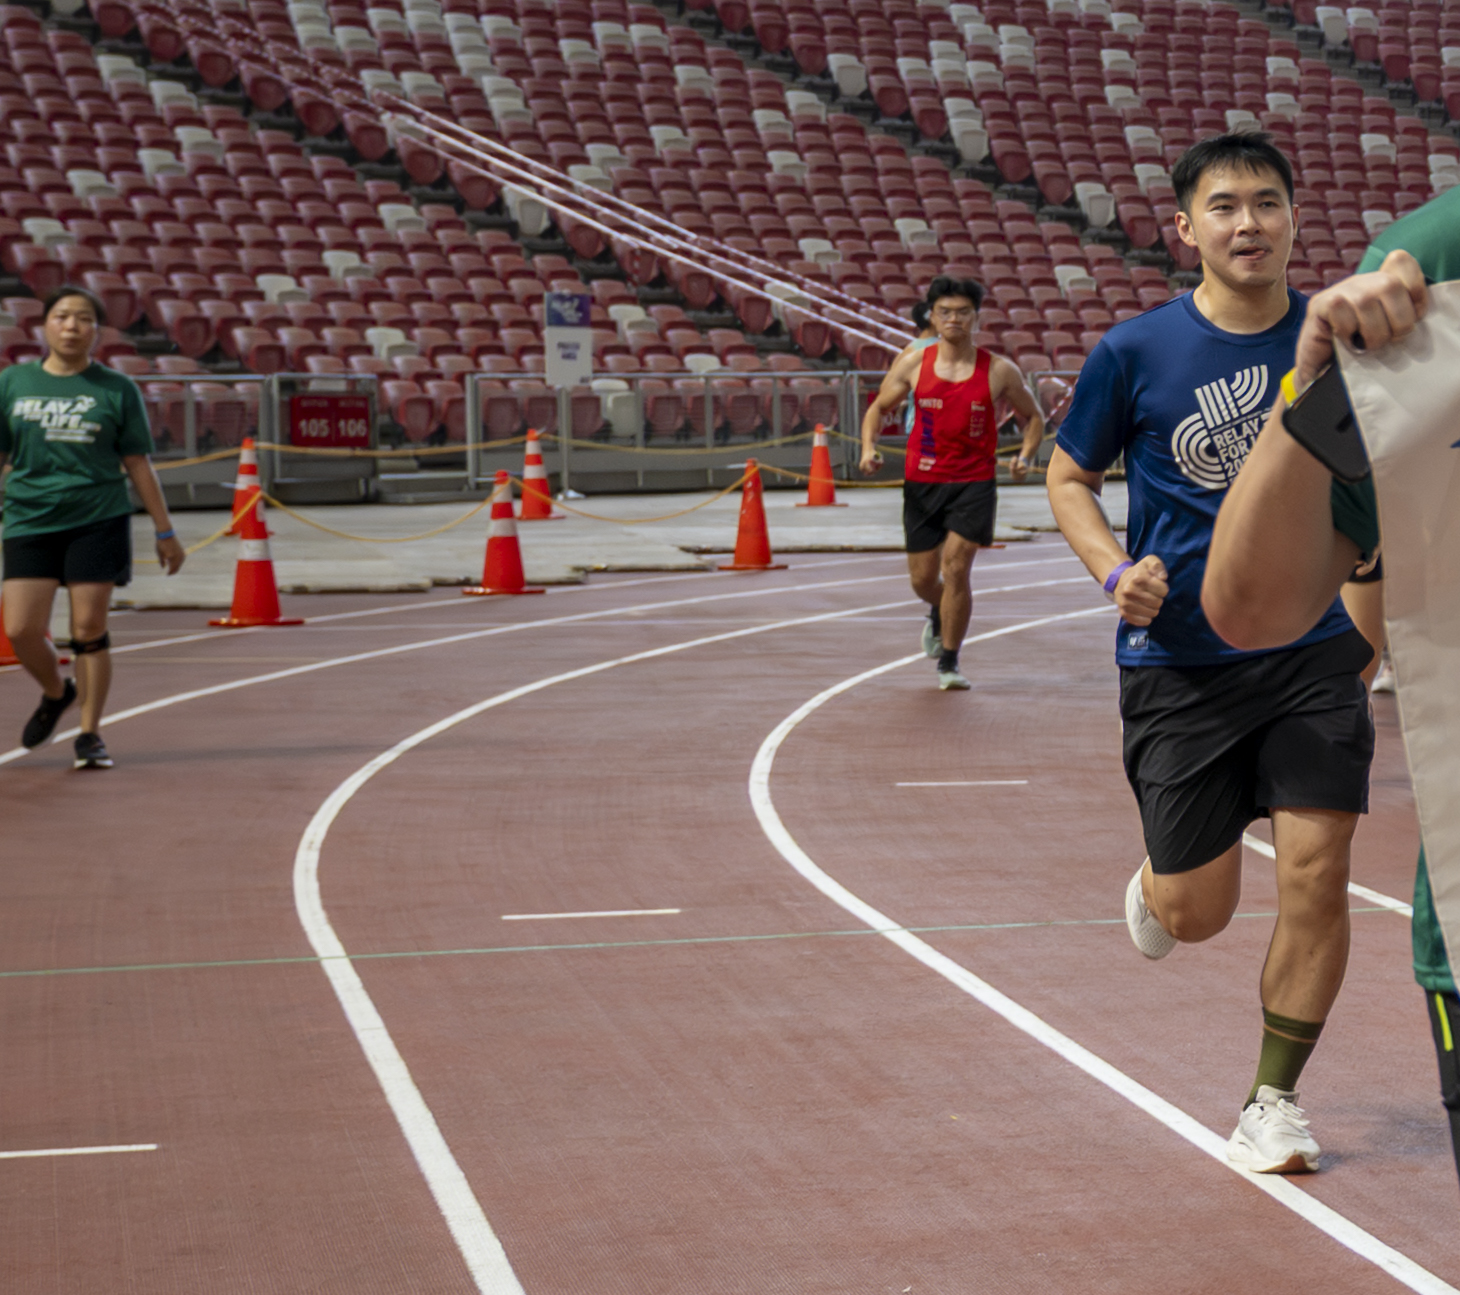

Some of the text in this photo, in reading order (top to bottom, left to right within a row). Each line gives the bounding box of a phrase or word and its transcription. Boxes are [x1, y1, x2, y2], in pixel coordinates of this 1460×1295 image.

[299, 418, 367, 438] 105 106
[1212, 417, 1260, 450] RELAY
